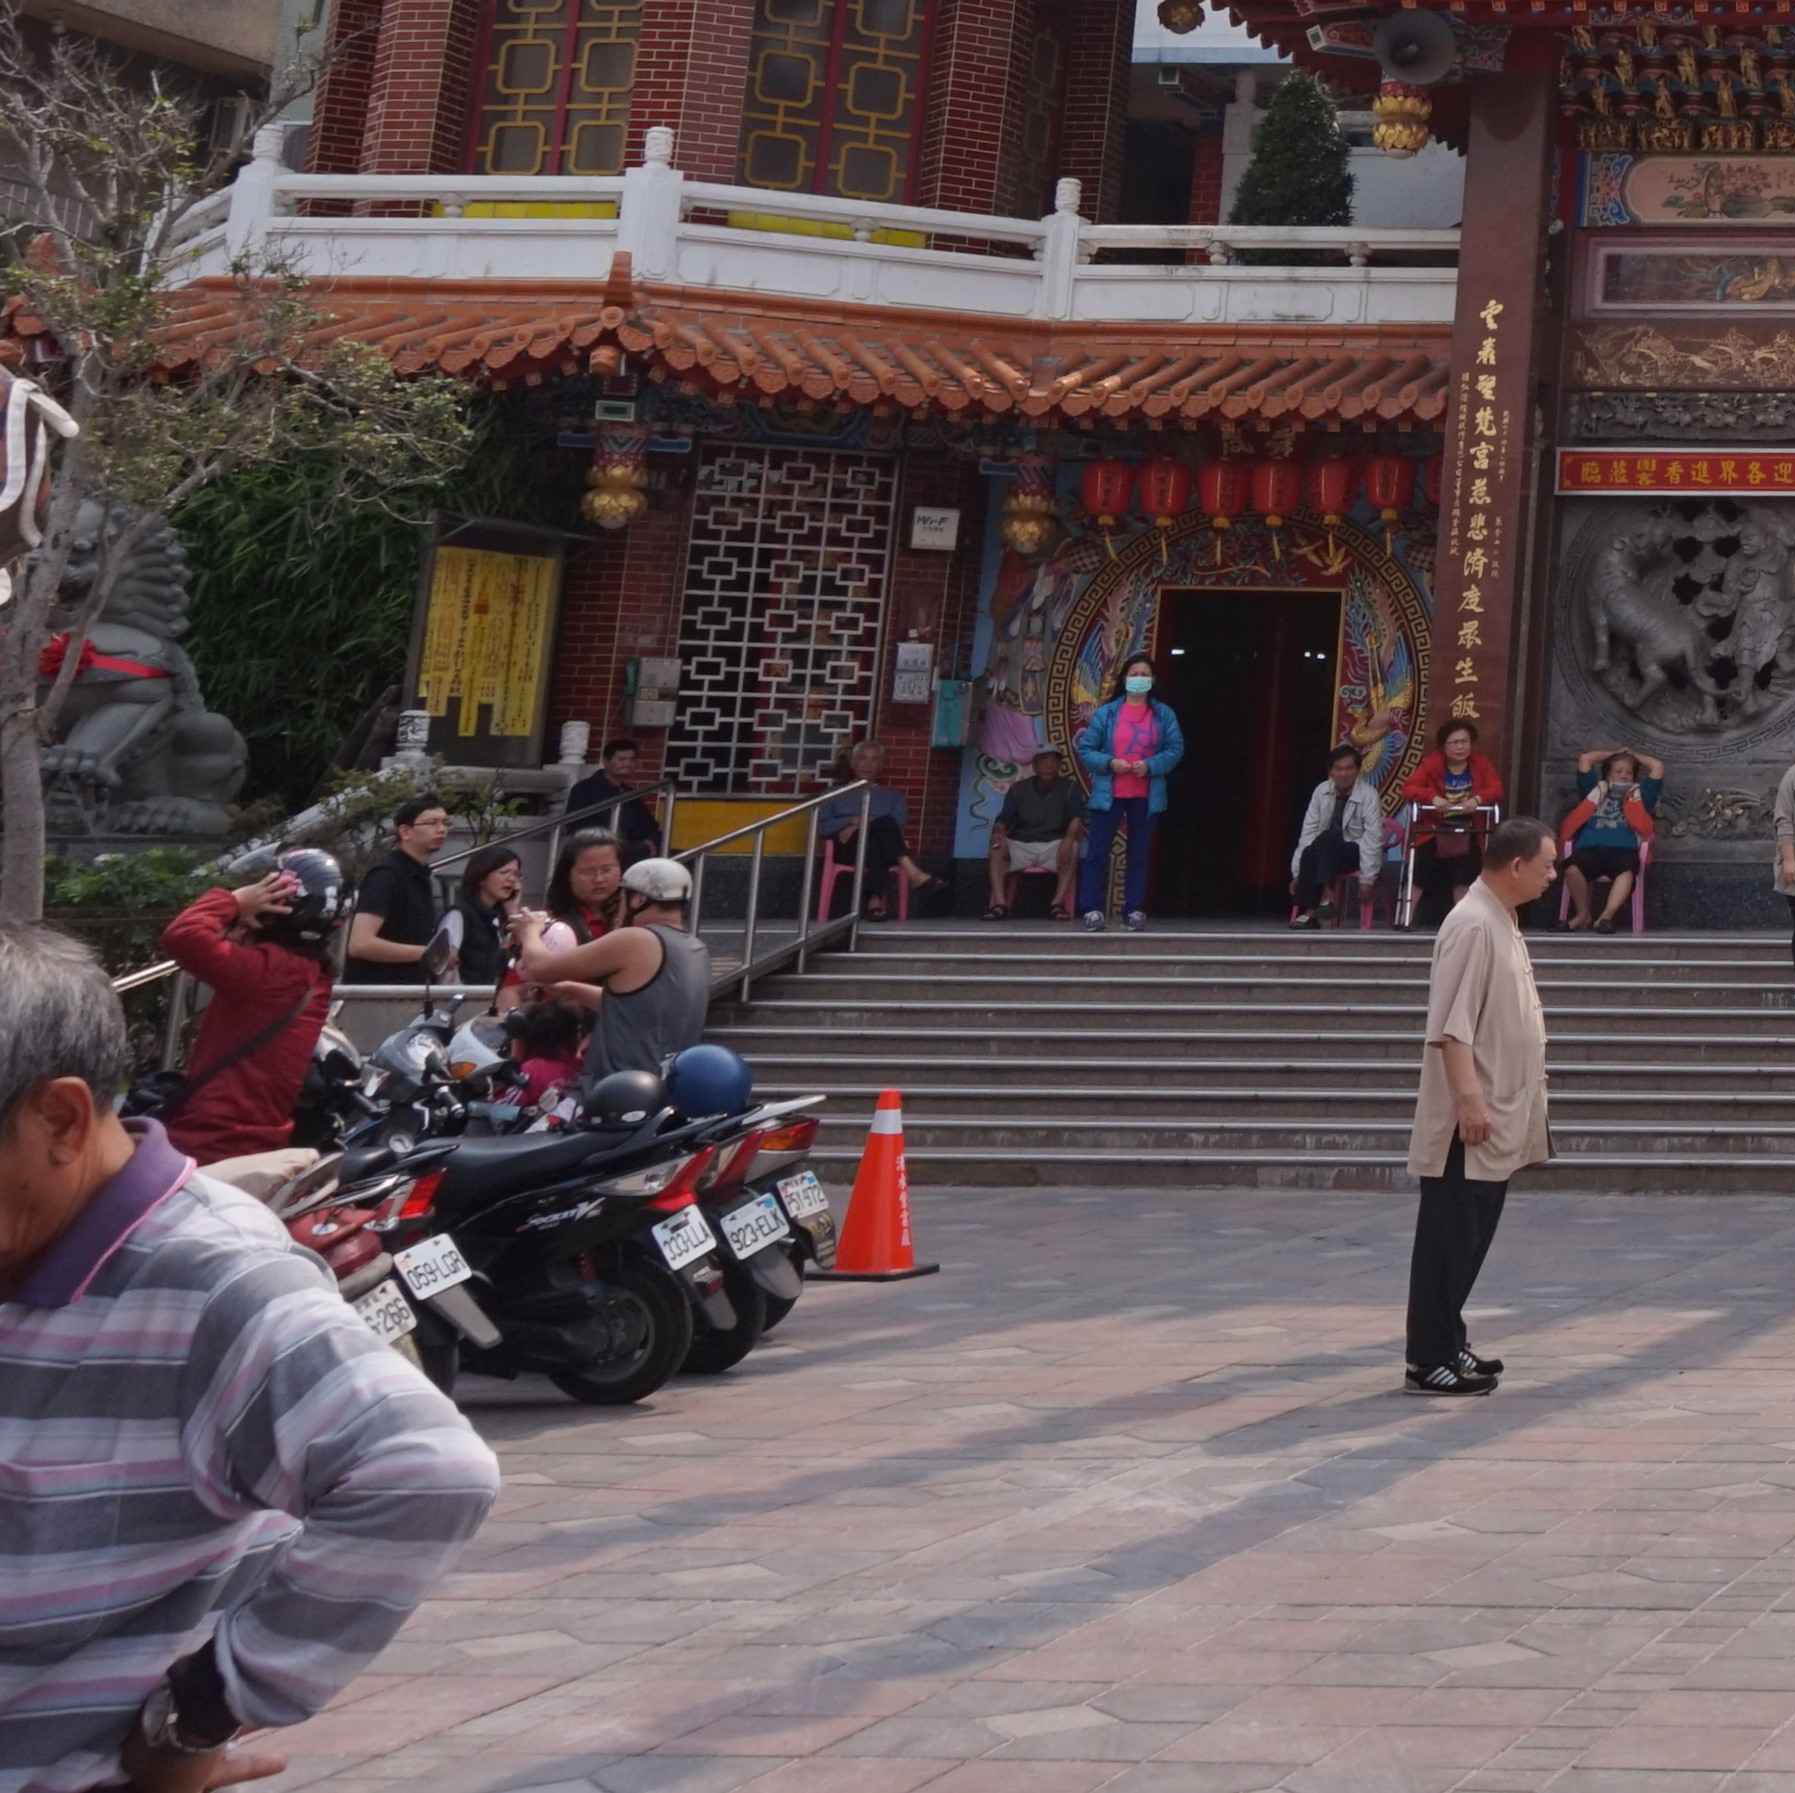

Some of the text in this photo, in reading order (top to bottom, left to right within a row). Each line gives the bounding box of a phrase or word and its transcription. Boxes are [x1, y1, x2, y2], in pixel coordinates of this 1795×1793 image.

[663, 1226, 714, 1261] 333-LLA
[729, 1208, 787, 1253] 923-ELK
[407, 1249, 467, 1292] 059-LGR
